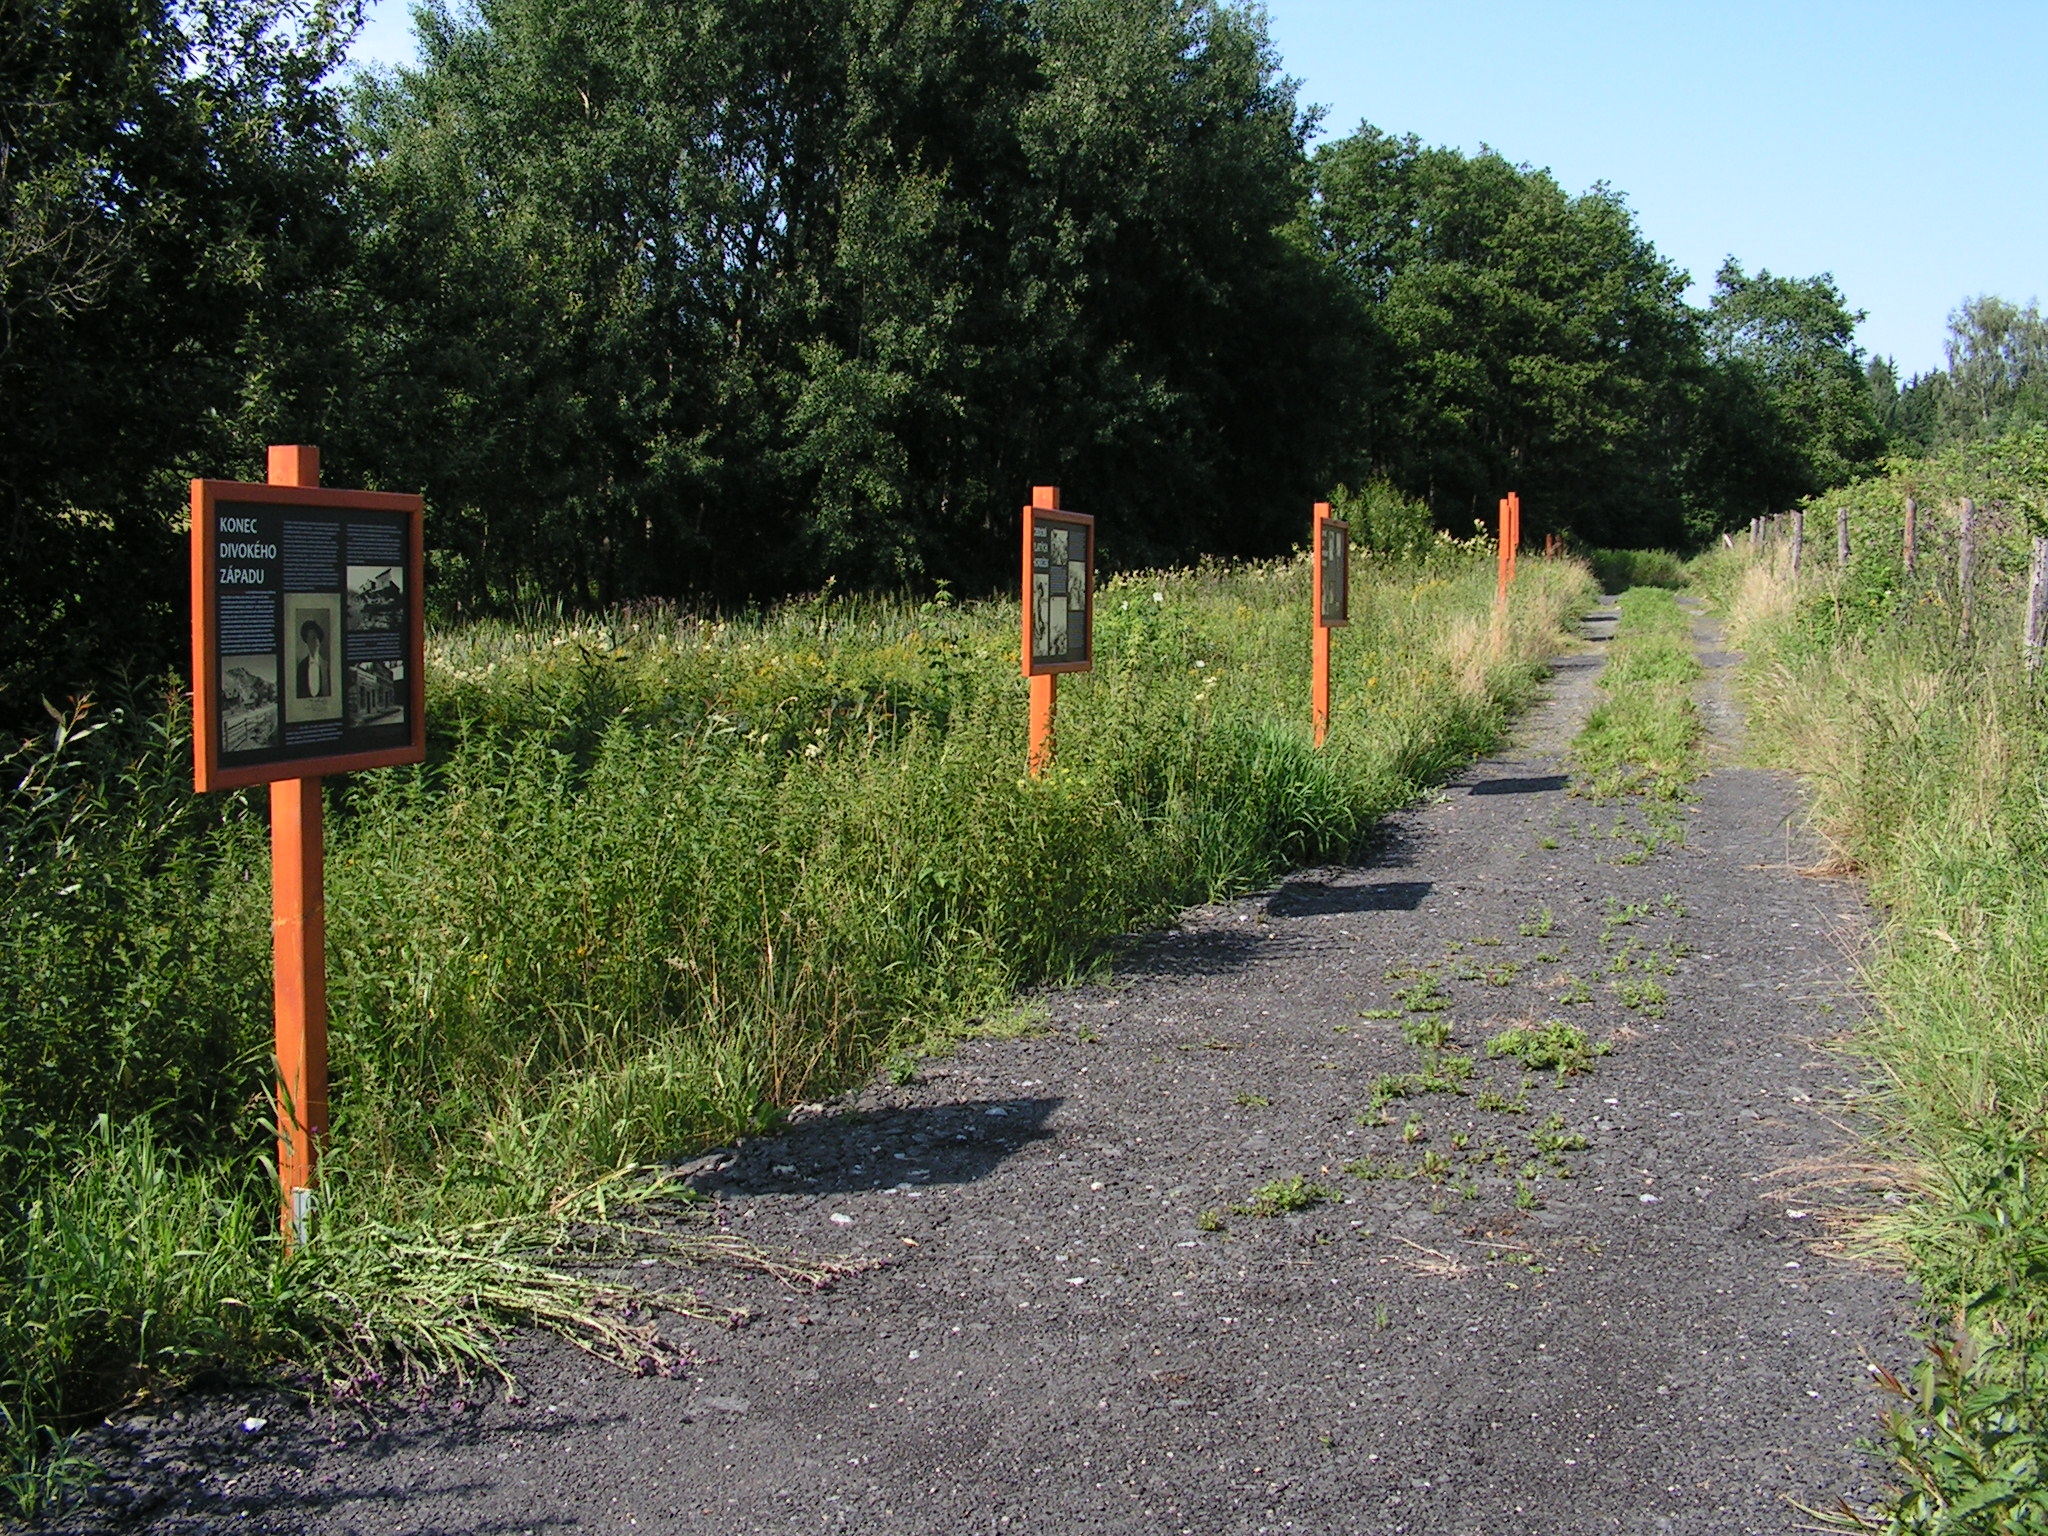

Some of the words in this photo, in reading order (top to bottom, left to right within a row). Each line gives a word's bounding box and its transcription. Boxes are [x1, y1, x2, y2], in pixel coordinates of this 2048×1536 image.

[220, 517, 258, 533] KONEC
[220, 541, 277, 560] DIVOKÉHO
[220, 565, 265, 584] ZÁPADU
